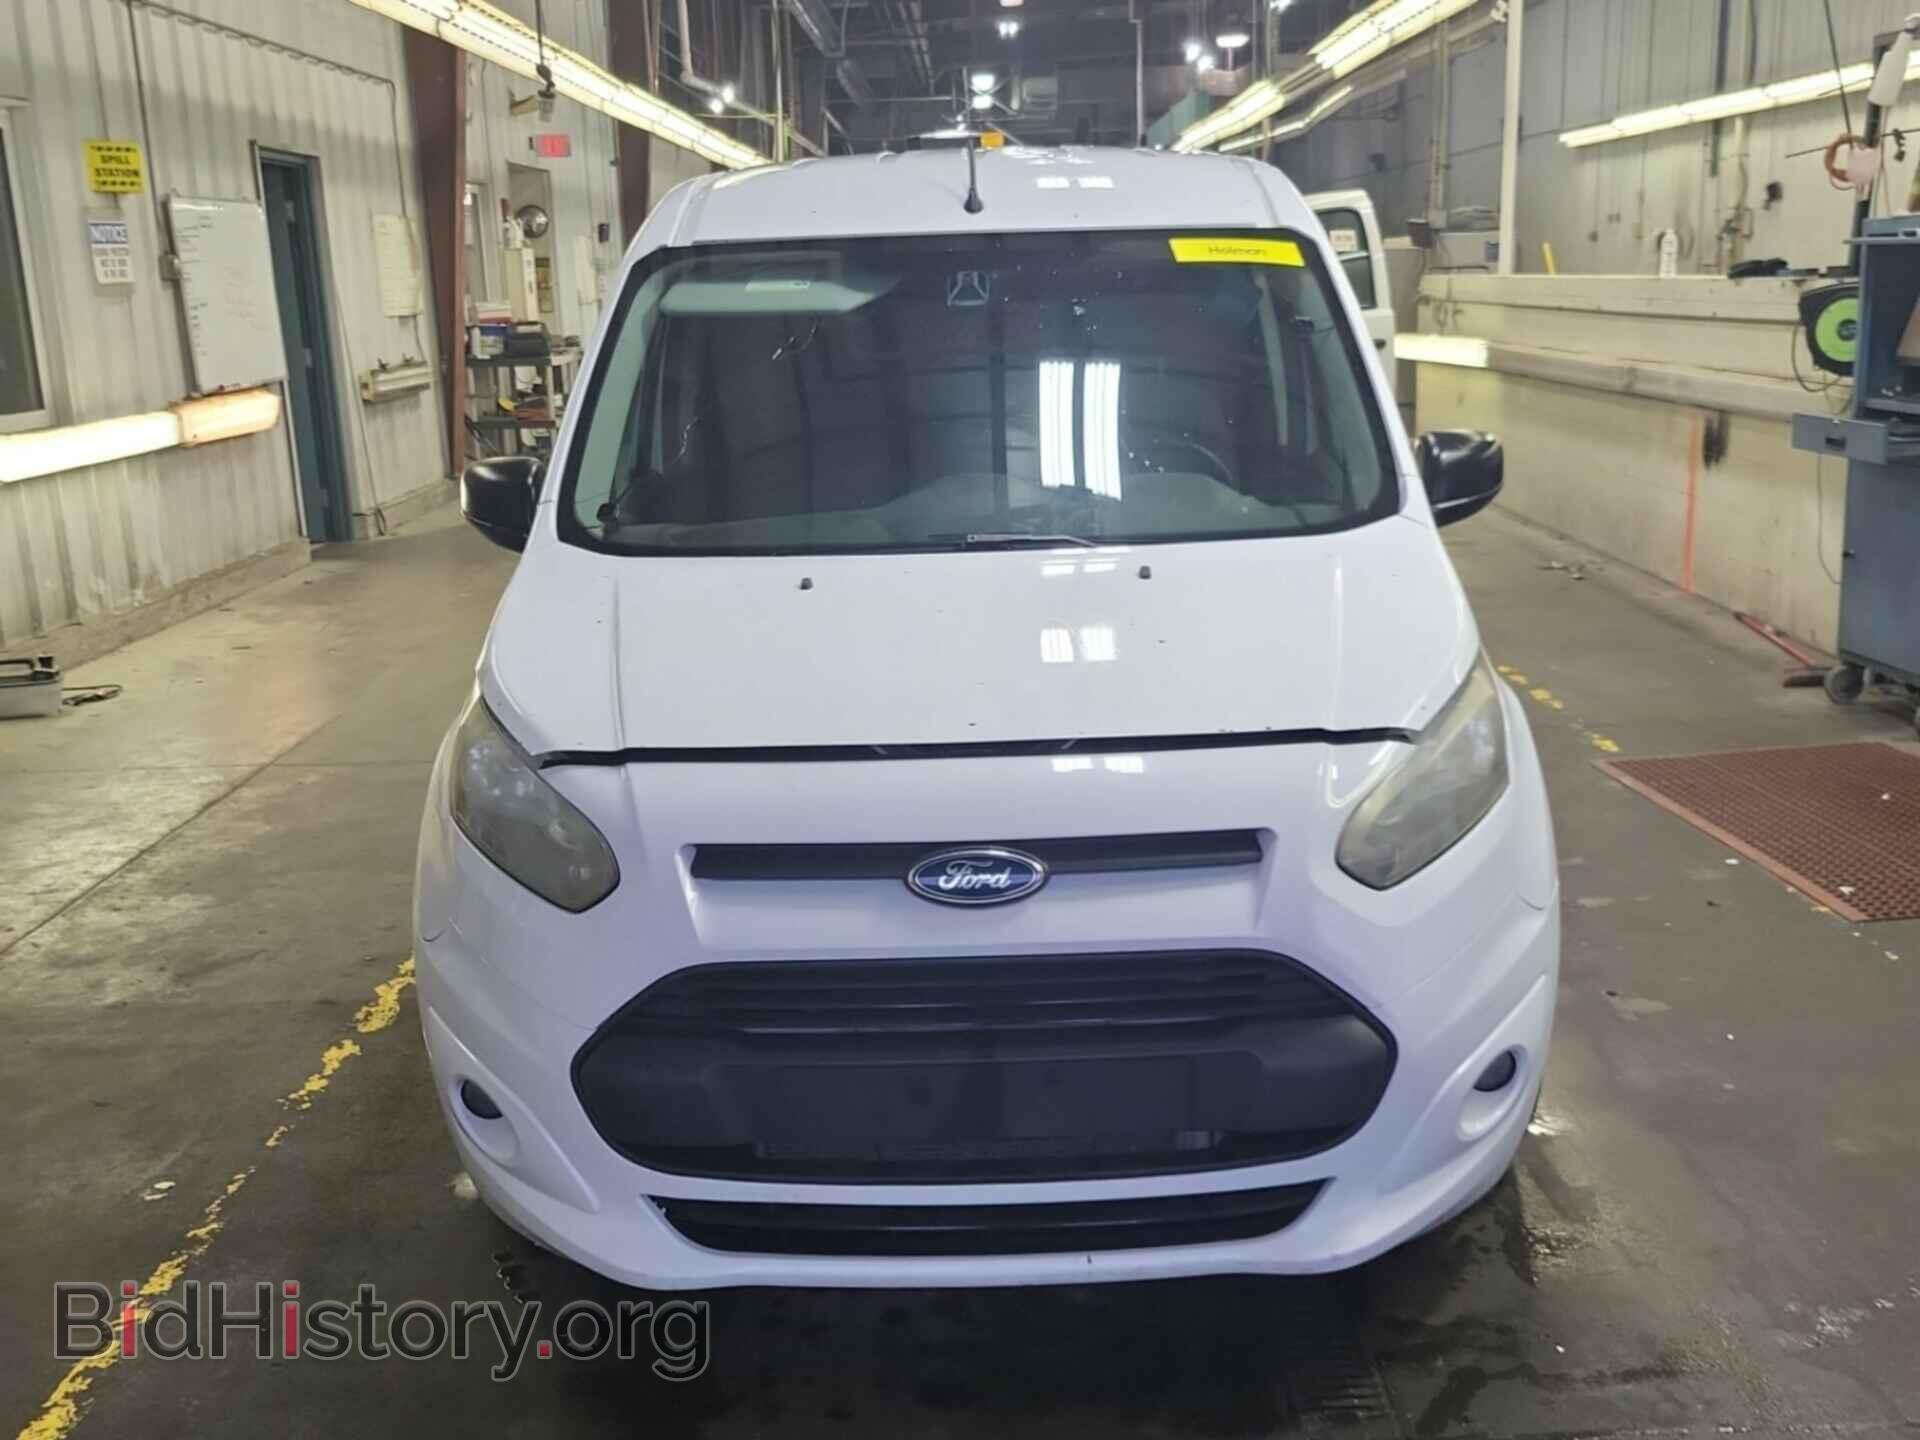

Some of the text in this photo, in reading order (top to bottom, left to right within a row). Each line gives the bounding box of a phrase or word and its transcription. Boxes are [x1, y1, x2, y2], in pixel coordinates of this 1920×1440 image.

[100, 155, 131, 165] SPILL
[94, 168, 139, 177] STATION
[938, 860, 1011, 890] Ford
